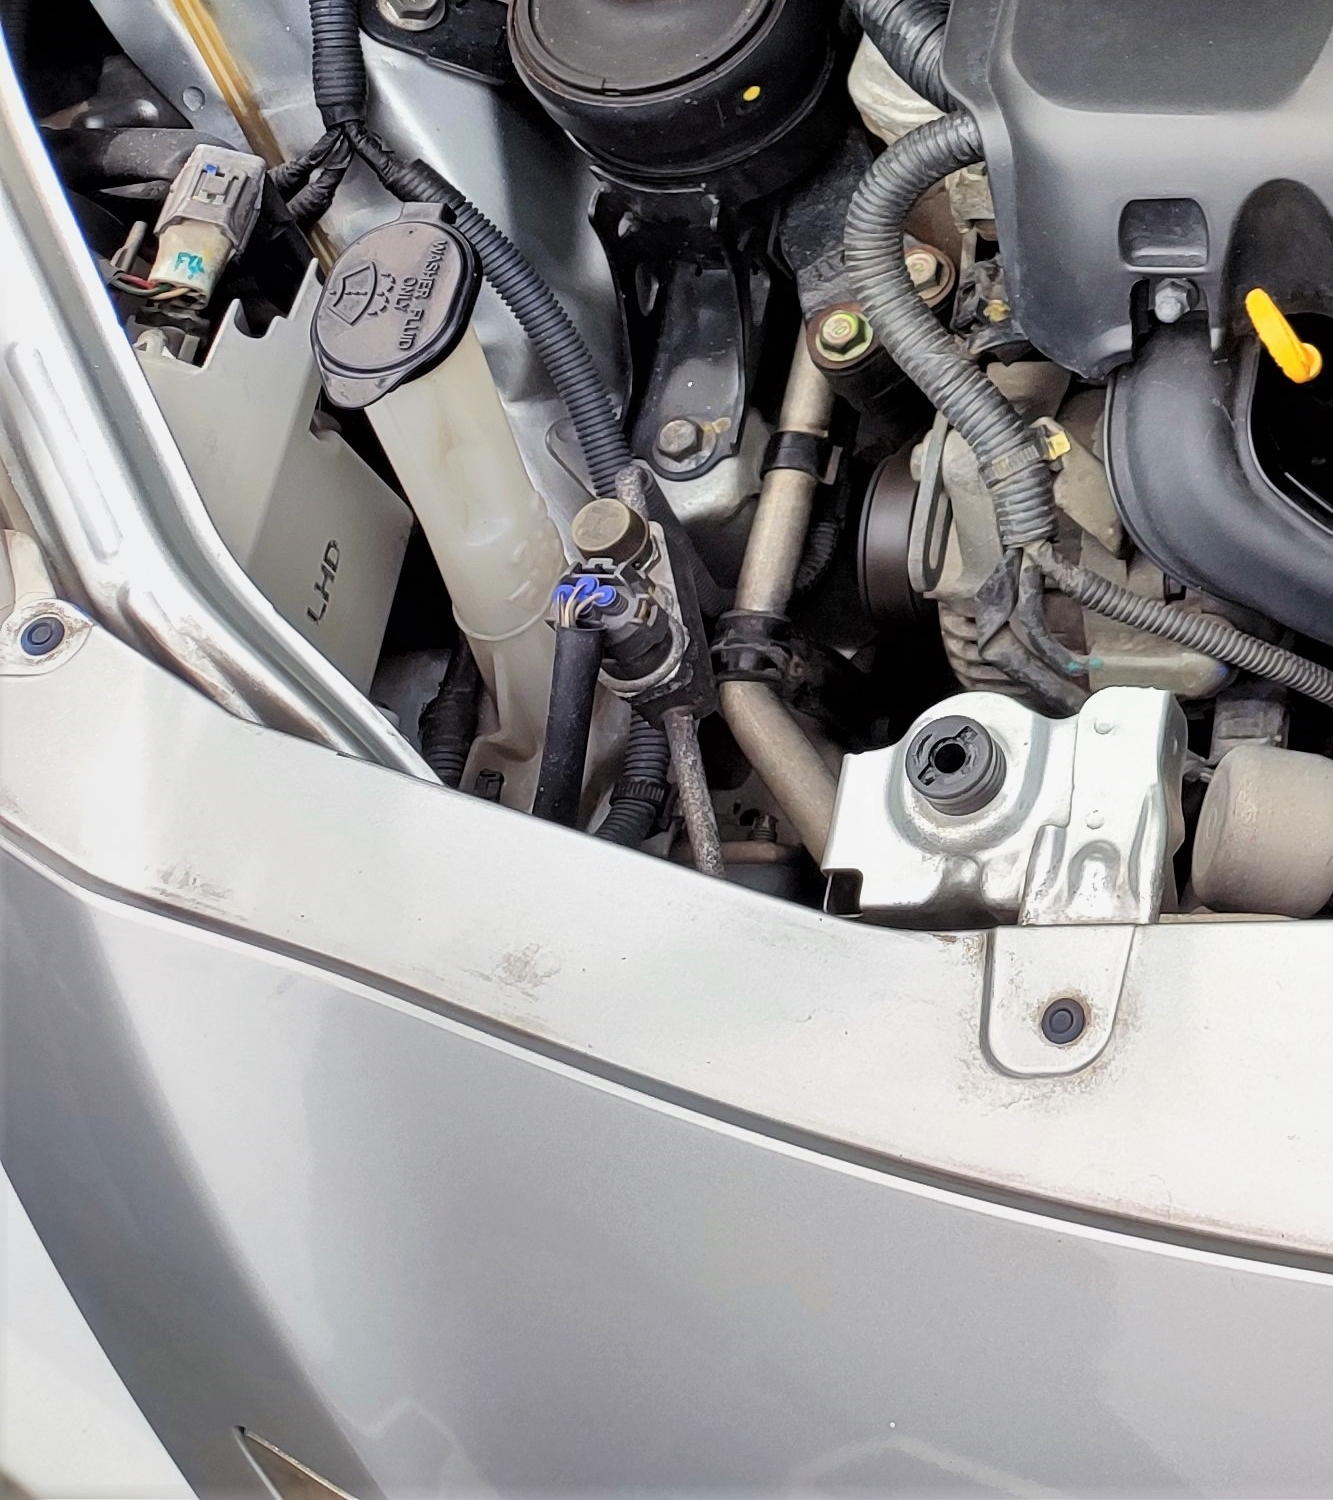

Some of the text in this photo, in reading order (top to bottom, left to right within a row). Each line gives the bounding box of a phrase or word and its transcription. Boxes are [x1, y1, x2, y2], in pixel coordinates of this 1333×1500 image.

[394, 276, 419, 315] ONLY
[398, 240, 448, 351] WASHER FLUID
[306, 538, 342, 624] LHD
